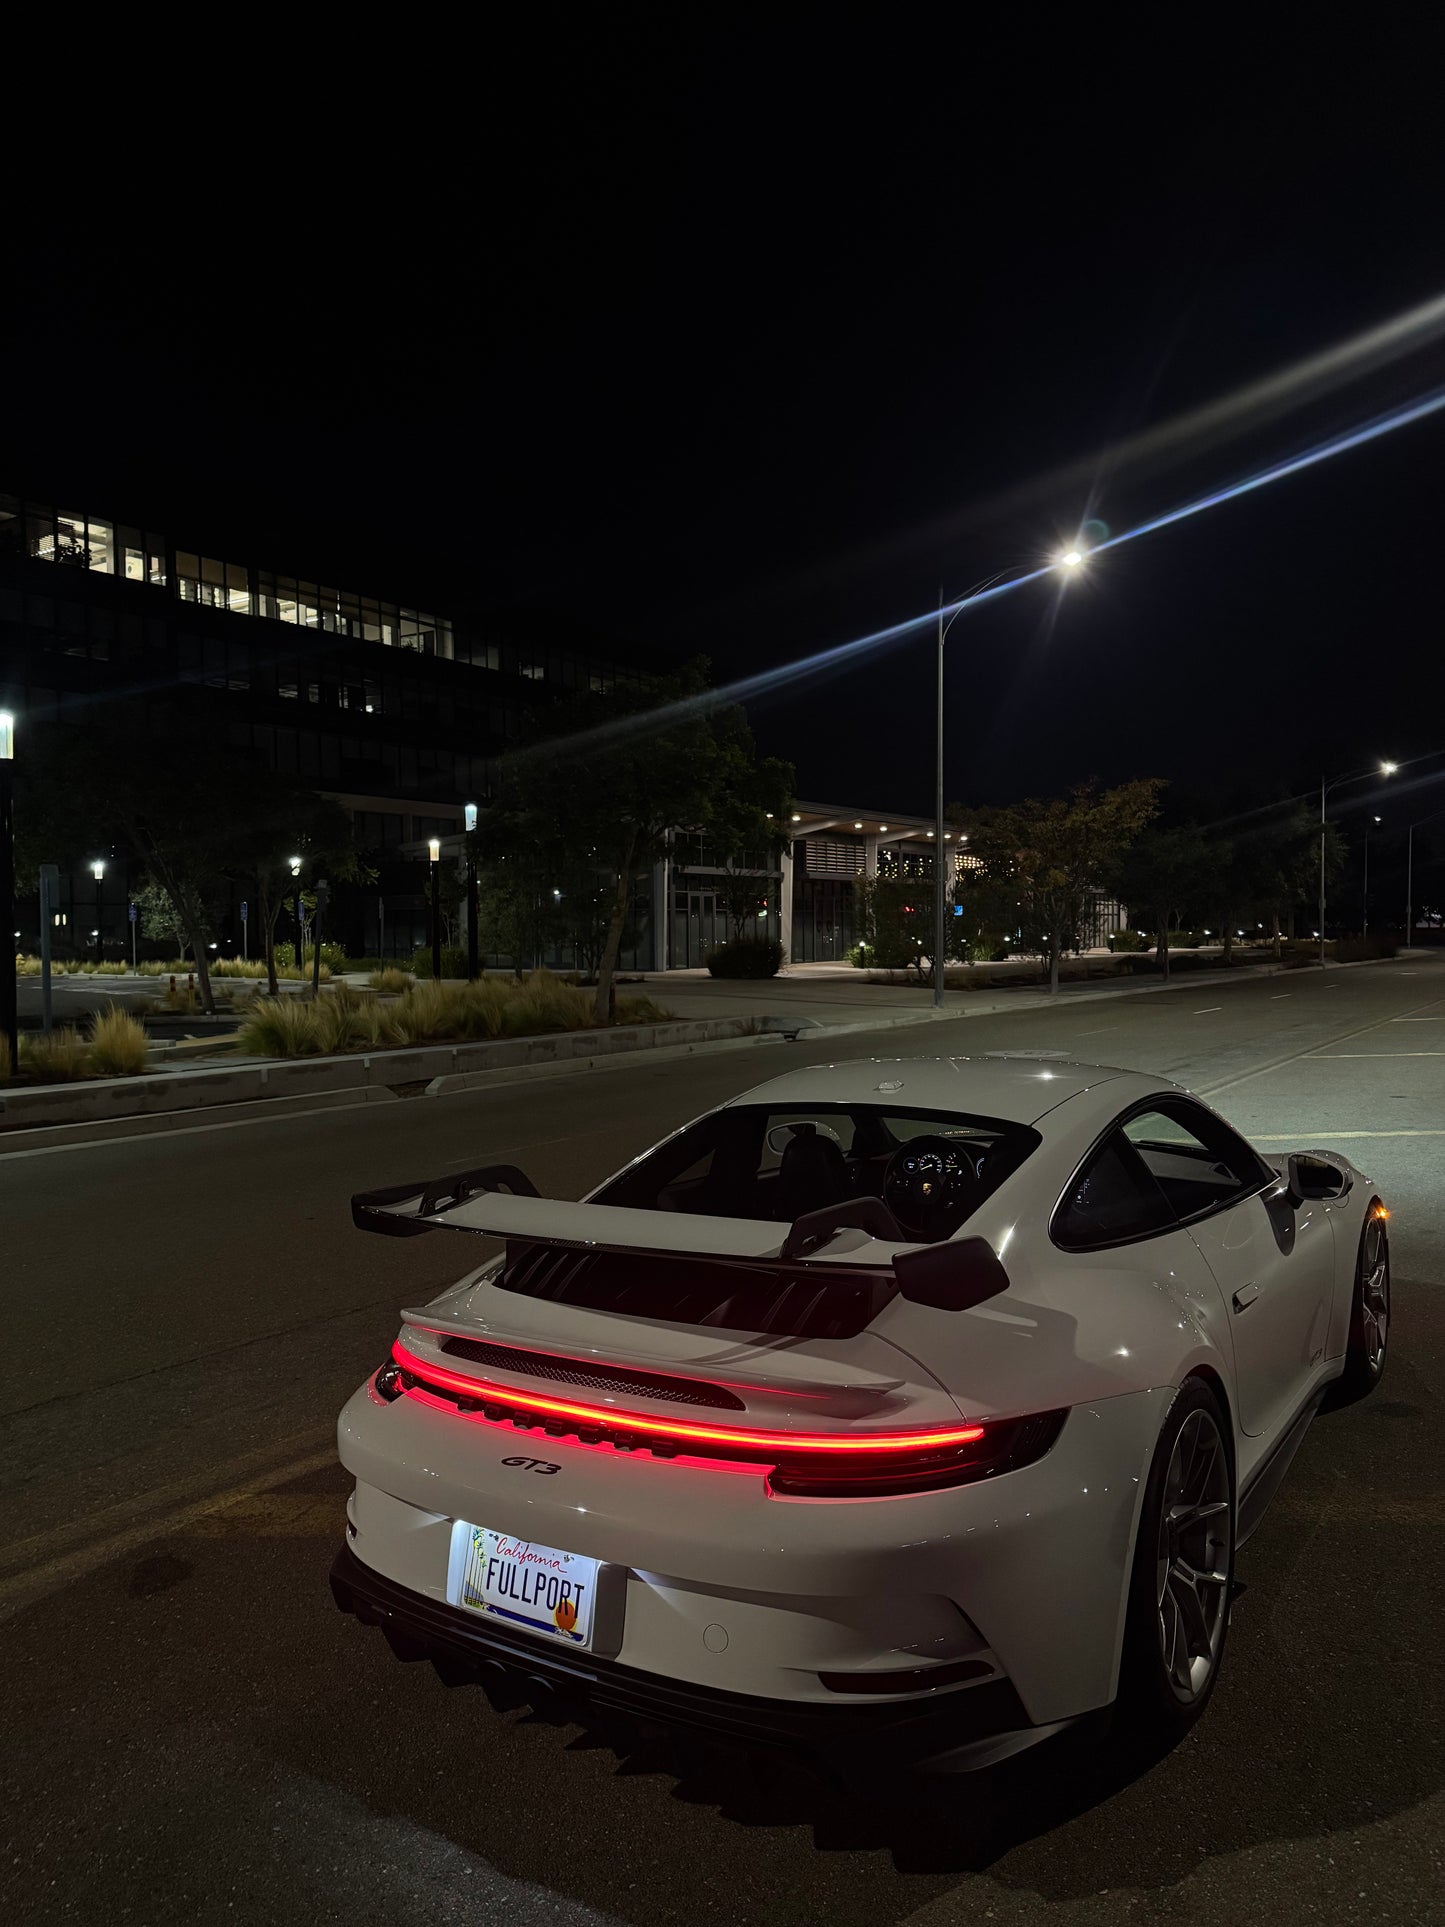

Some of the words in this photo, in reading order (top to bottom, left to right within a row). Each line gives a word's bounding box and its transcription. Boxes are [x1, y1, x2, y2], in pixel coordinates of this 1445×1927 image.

[501, 1456, 562, 1475] GT3
[495, 1536, 567, 1574] California
[485, 1557, 585, 1619] FULLPORT
